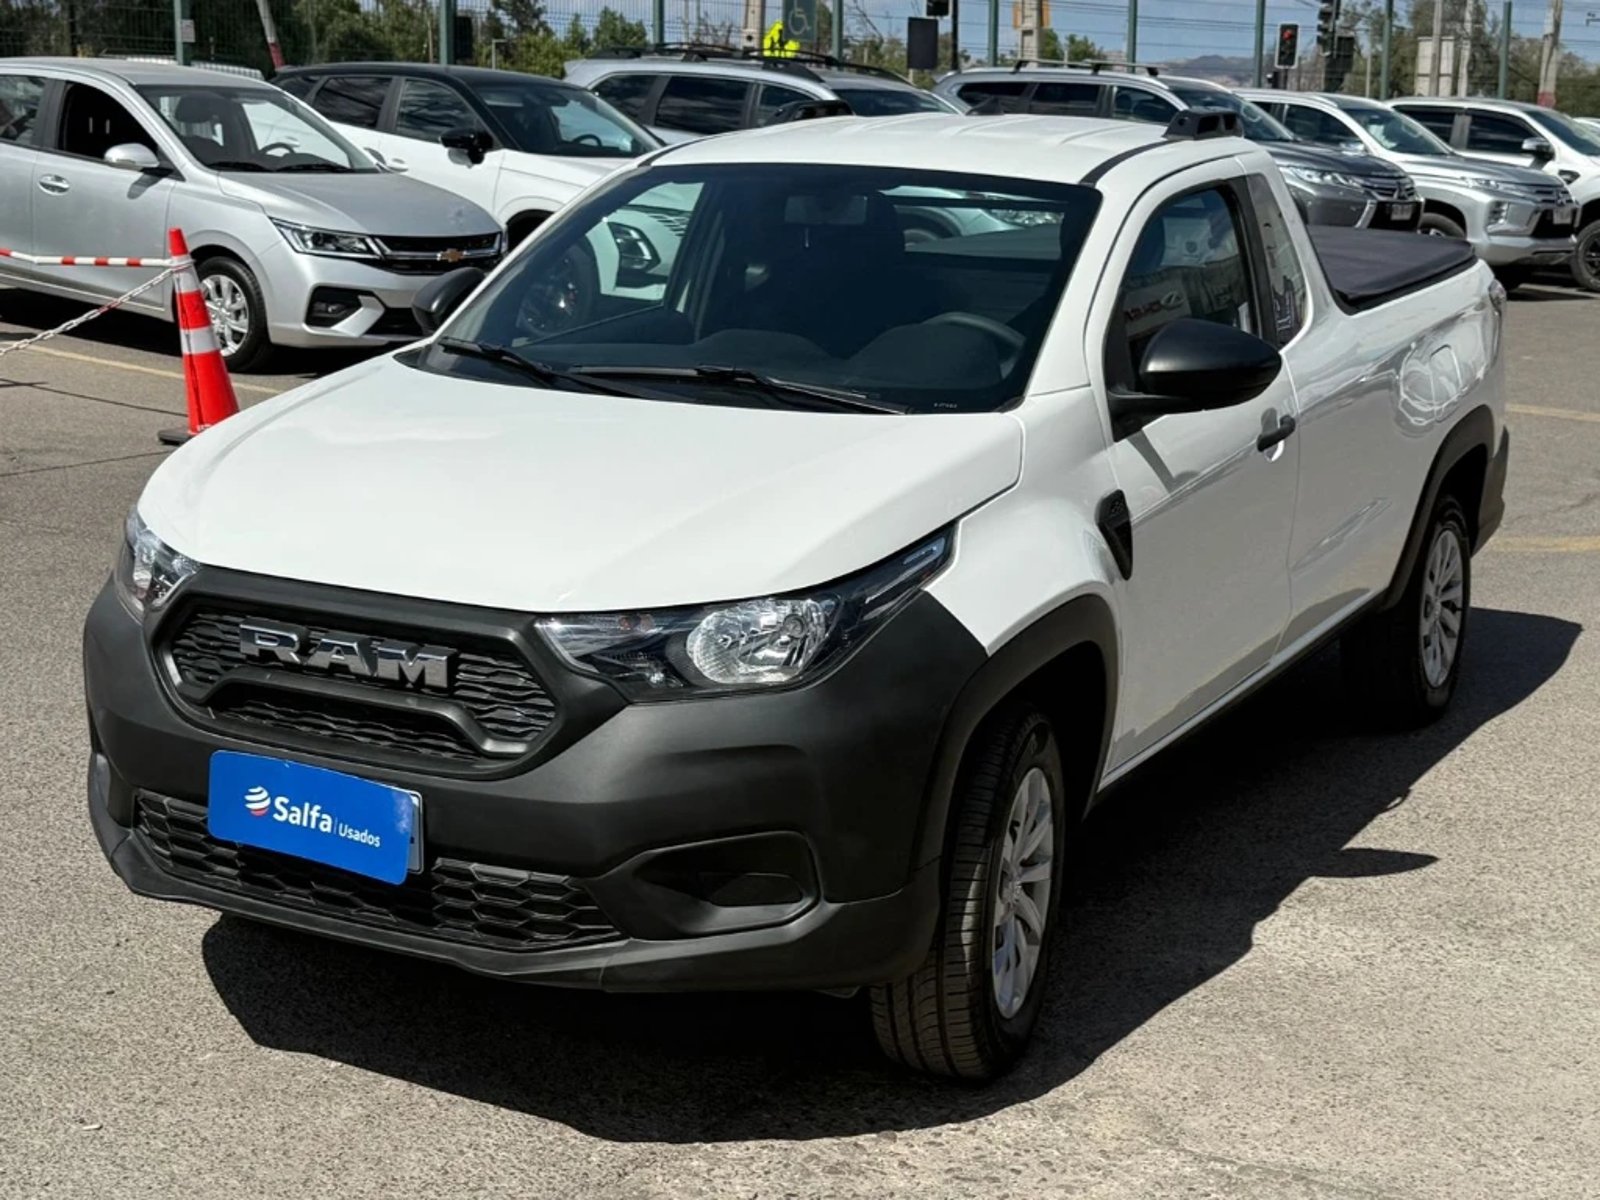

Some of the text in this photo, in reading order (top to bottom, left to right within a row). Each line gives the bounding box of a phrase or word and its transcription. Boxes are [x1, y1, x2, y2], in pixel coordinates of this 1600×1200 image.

[239, 617, 456, 689] RAM
[273, 796, 381, 848] Salfa Usados
